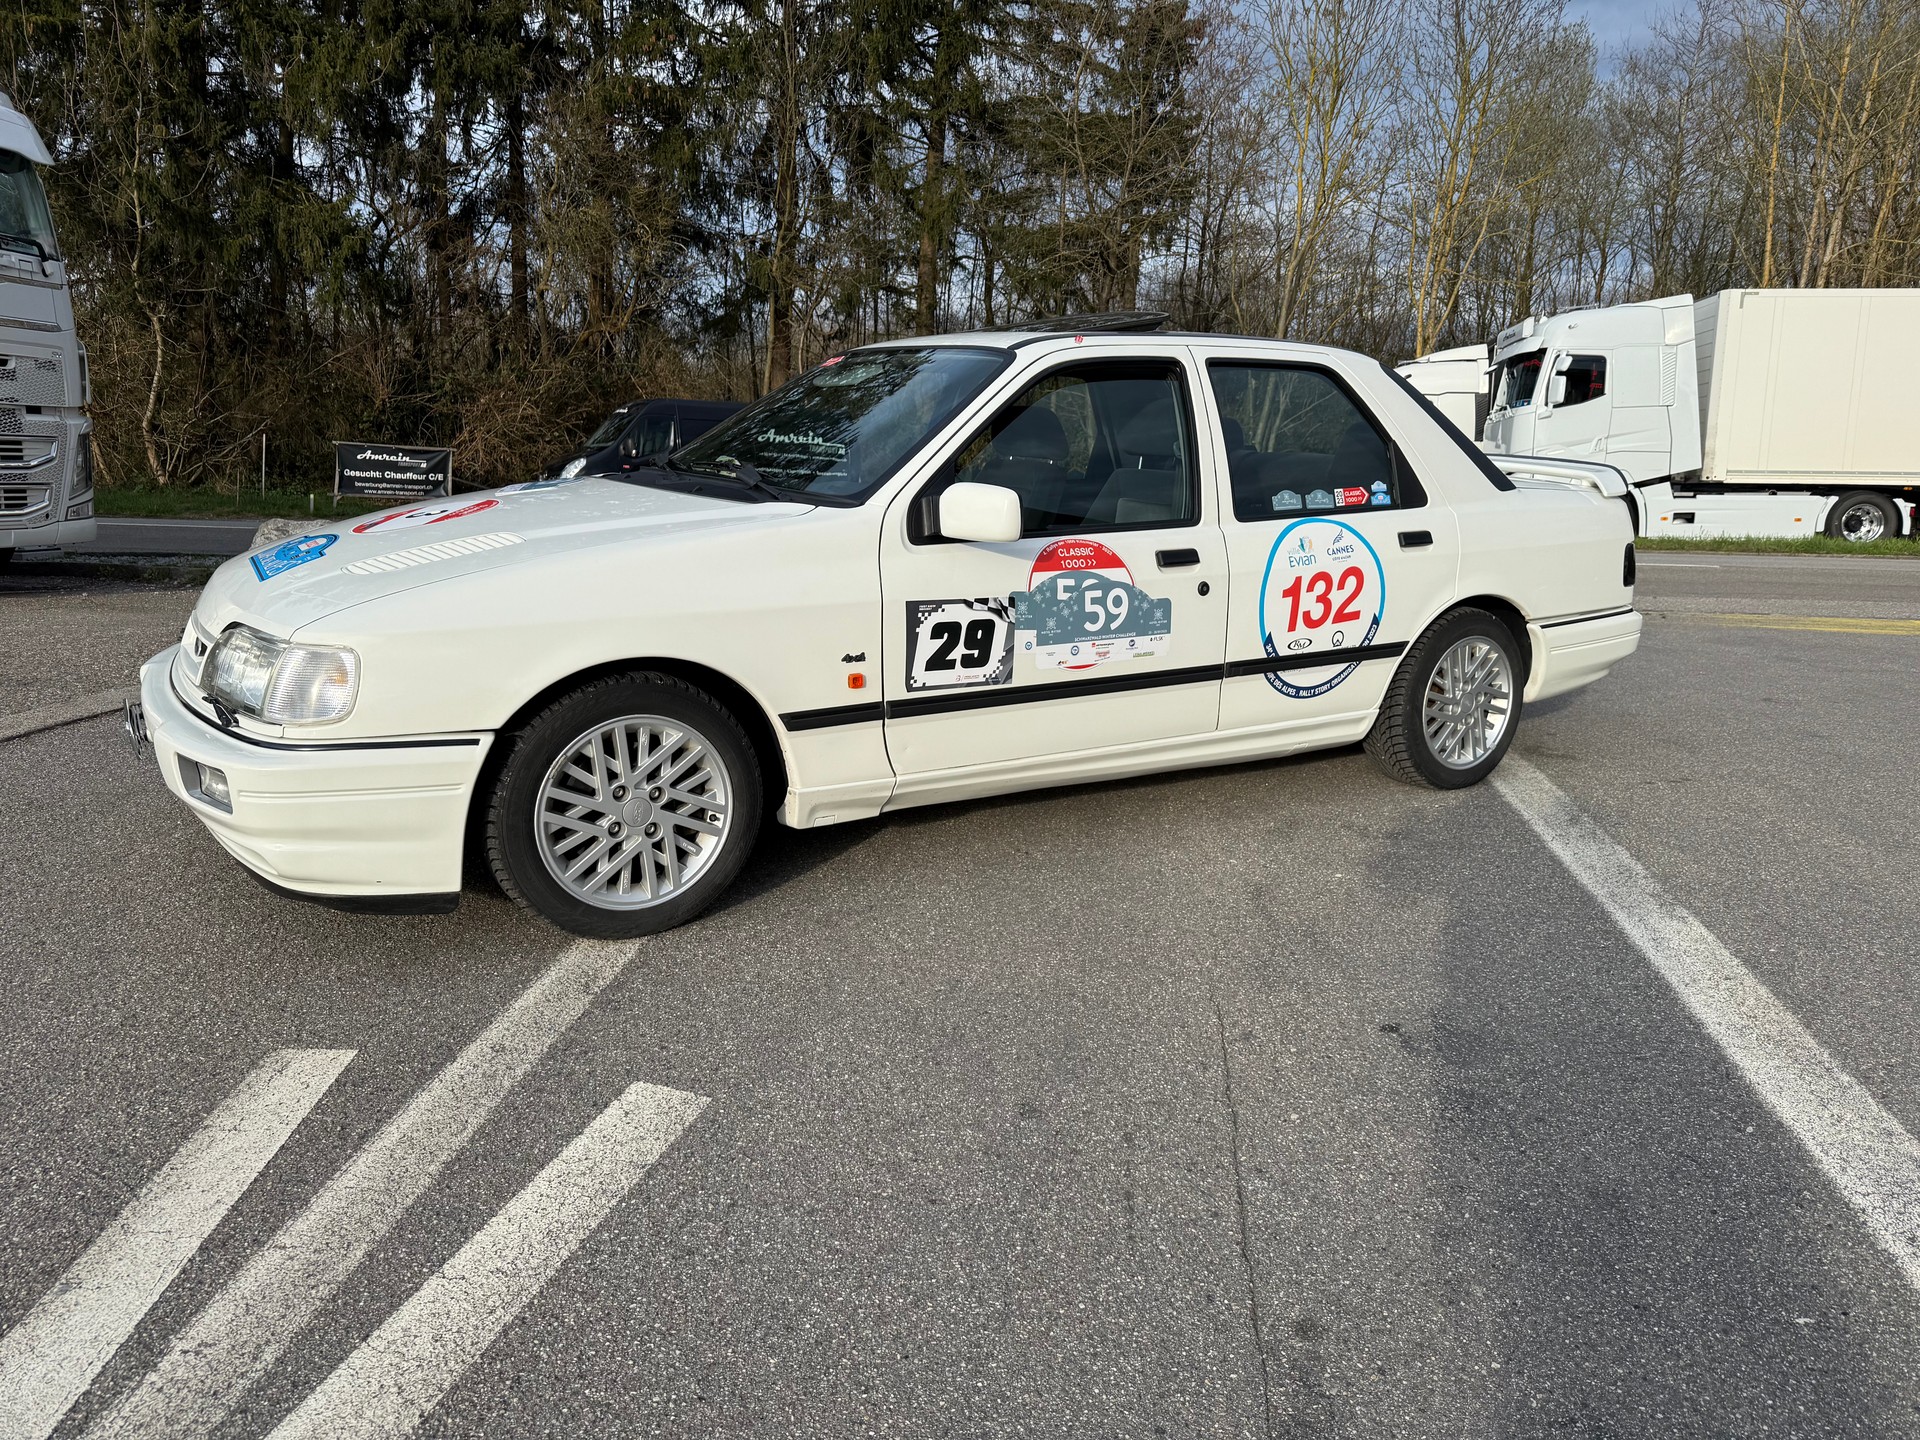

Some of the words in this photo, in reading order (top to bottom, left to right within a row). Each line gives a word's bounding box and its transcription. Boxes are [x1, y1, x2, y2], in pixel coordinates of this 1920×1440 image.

[758, 428, 824, 444] Amrein
[356, 449, 411, 462] Amrein
[343, 468, 382, 479] Gesucht:
[384, 470, 427, 481] Chauffeur
[428, 473, 444, 481] C/E
[354, 480, 433, 490] bewerbung@amrein-transport.ch
[363, 488, 425, 497] www.amrein-transport.ch
[1057, 547, 1095, 557] CLASSIC
[1326, 544, 1355, 556] CANNES
[1060, 558, 1086, 568] 1000
[1281, 565, 1365, 633] 132
[1083, 587, 1129, 632] 59
[924, 618, 996, 672] 29
[841, 652, 867, 664] 4x4
[1299, 688, 1315, 697] RALLY
[1314, 682, 1331, 695] STORY
